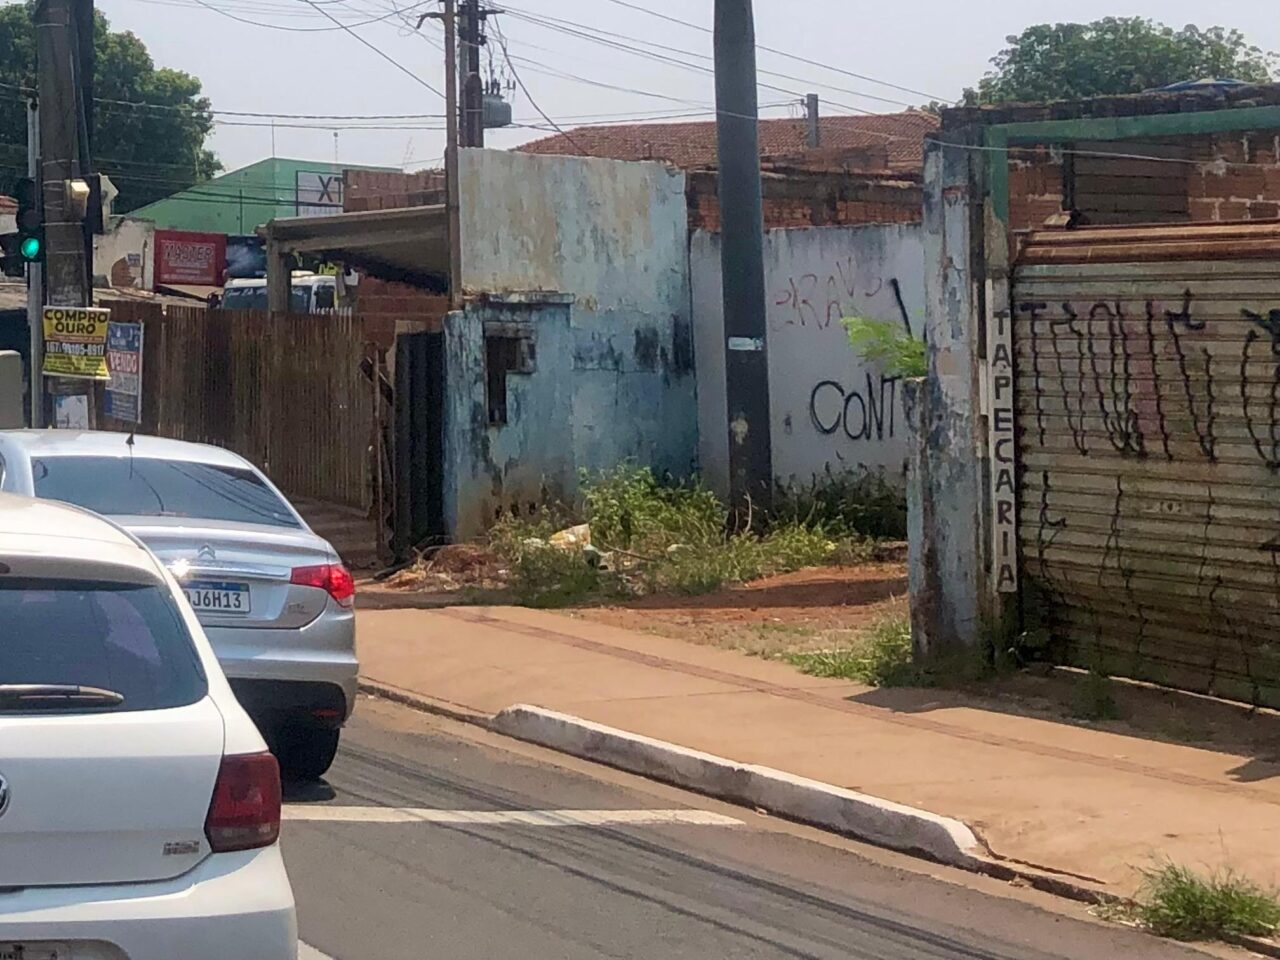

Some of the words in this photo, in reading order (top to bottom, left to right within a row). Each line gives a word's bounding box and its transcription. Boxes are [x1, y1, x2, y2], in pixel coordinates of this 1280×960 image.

[164, 243, 213, 260] MASTER
[44, 309, 108, 323] COMPRO
[55, 322, 96, 334] OURO
[110, 352, 138, 373] VENDO
